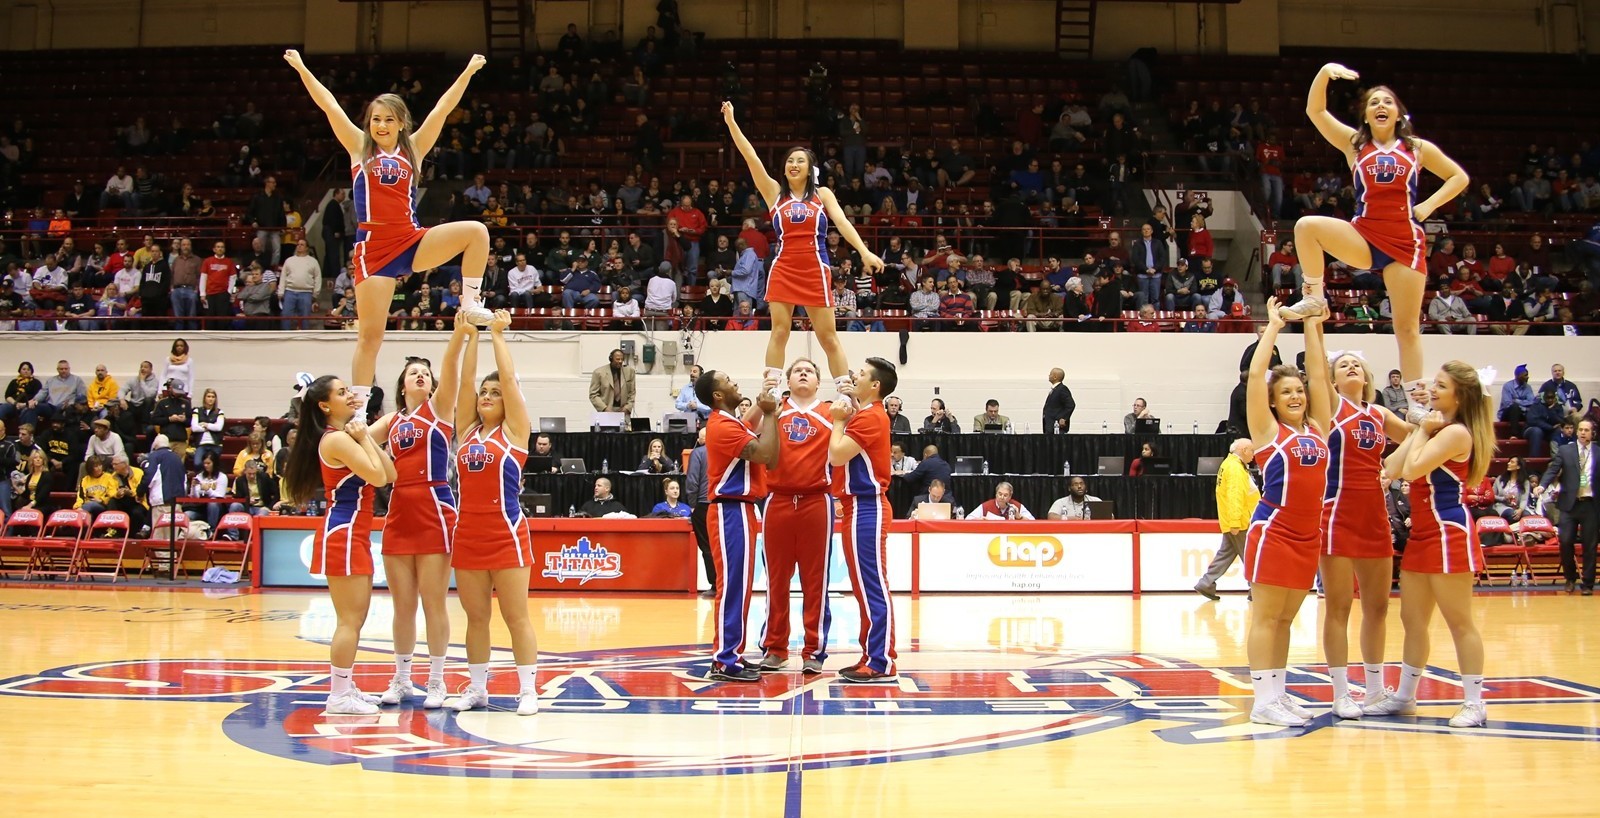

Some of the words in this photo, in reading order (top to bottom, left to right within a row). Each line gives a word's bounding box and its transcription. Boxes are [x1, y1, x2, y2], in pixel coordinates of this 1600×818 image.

[372, 166, 408, 179] TITANS
[1366, 164, 1405, 176] TITANS
[784, 209, 814, 219] TITANS
[393, 429, 424, 443] TITANS
[783, 423, 817, 437] TITANS
[1351, 428, 1384, 444] TITANS
[461, 452, 494, 464] TITANS
[1291, 446, 1325, 458] TITANS
[549, 555, 617, 571] TITANS
